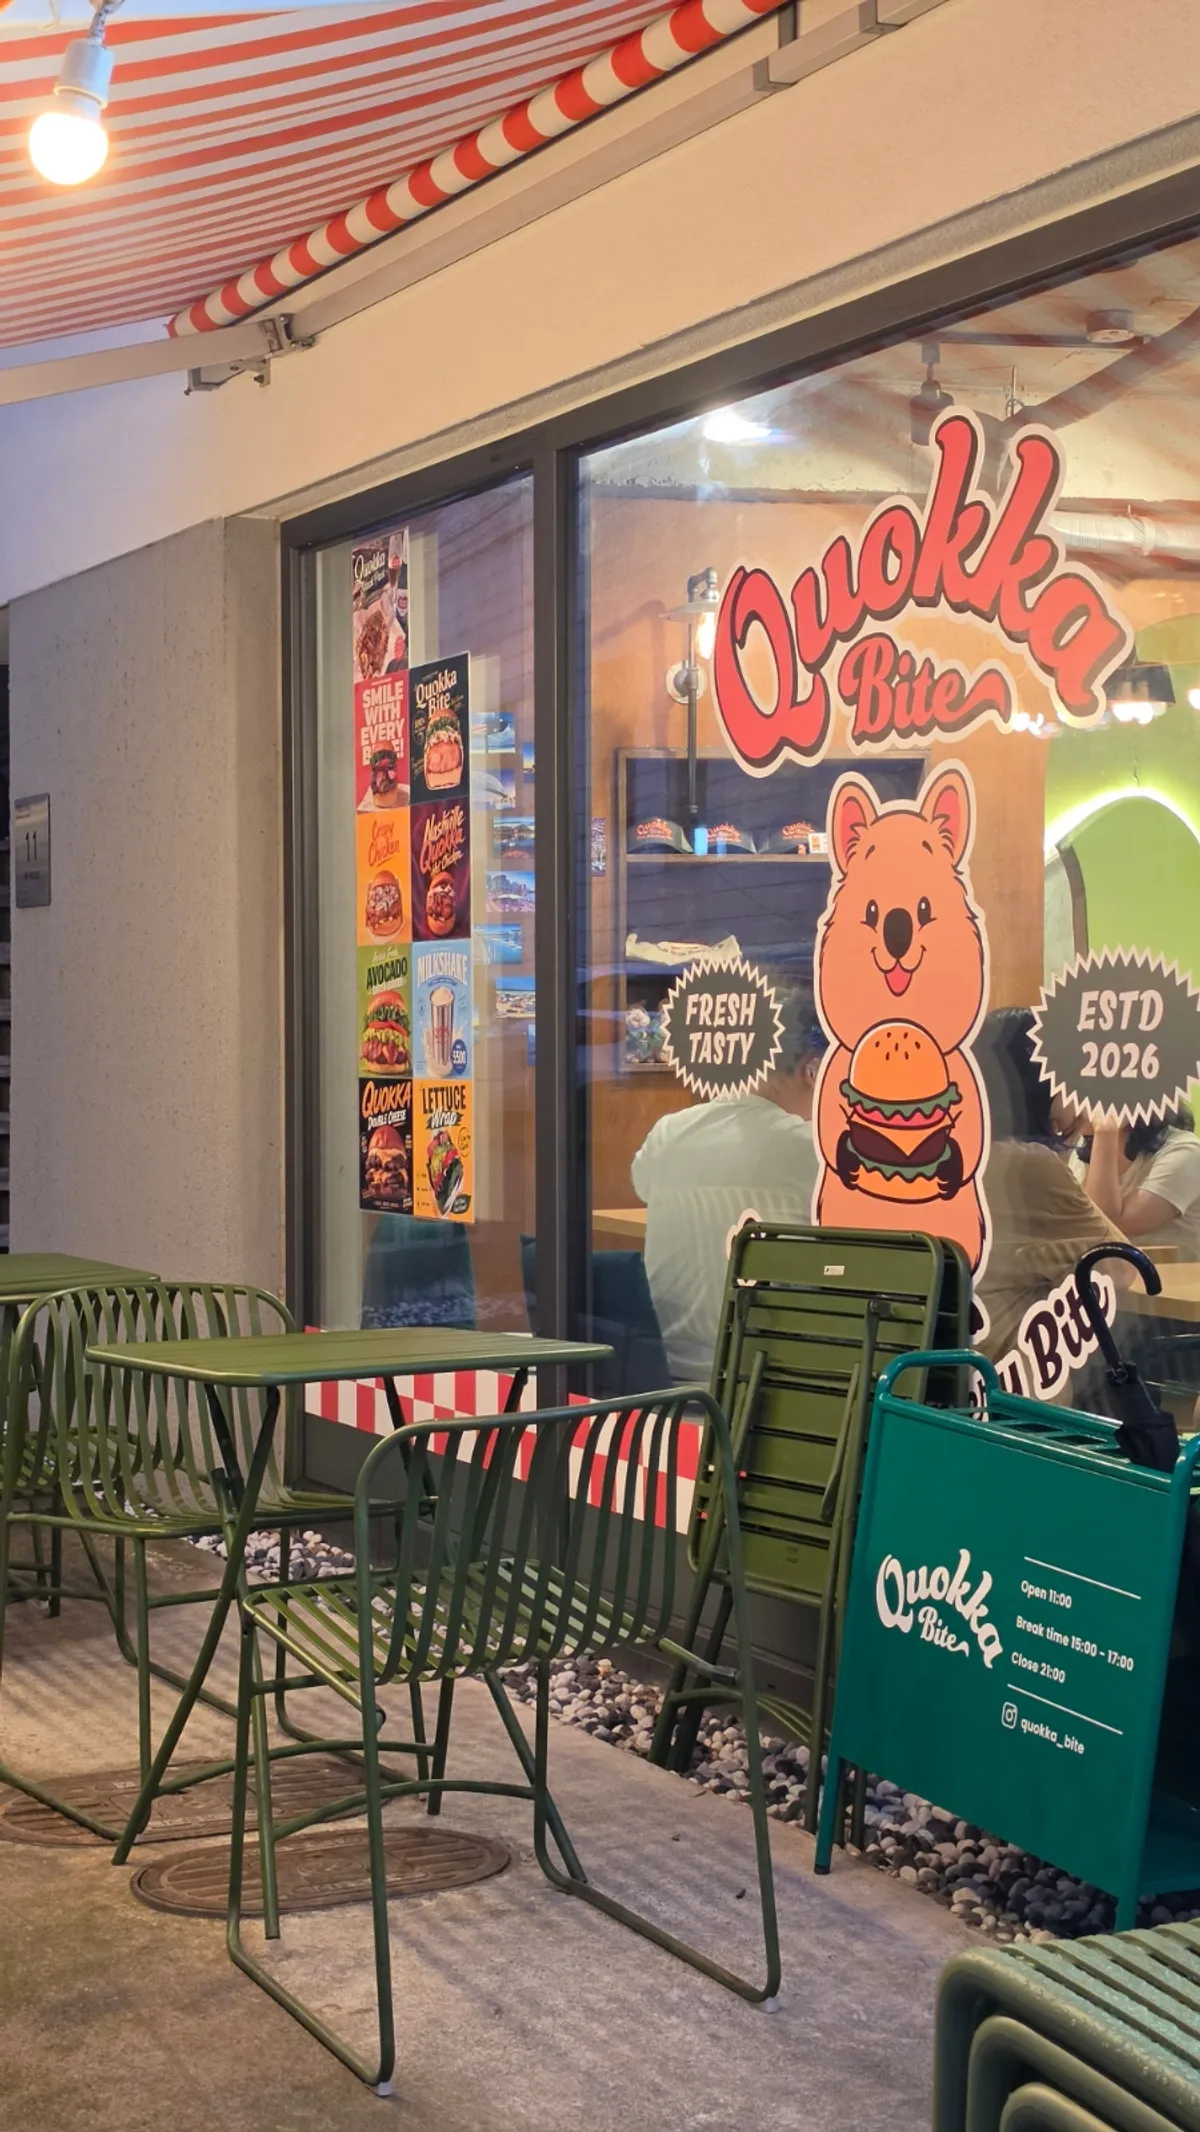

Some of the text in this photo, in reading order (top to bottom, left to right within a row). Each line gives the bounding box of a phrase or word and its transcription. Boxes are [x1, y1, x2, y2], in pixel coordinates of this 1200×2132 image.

[714, 413, 1129, 769] Quokka
[362, 681, 404, 709] SMILE
[416, 669, 457, 709] Quokka
[429, 692, 450, 718] Bite
[838, 631, 1011, 747] Bite
[365, 701, 401, 727] WITH
[361, 718, 405, 748] EVERY
[362, 738, 404, 767] BE!
[423, 805, 465, 843] Nashville
[25, 831, 37, 862] 11
[368, 838, 399, 867] Chicken
[420, 828, 465, 874] Quokka
[366, 956, 408, 990] AVOCADO
[417, 951, 468, 988] MILKSHAKE
[685, 992, 757, 1028] FRESH
[1077, 989, 1164, 1032] ESTD
[689, 1031, 756, 1066] TASTY
[1080, 1041, 1161, 1080] 2026
[362, 1080, 412, 1119] QUOKKA
[422, 1085, 466, 1114] LETTUCE
[367, 1114, 389, 1131] DOUBLE
[431, 1110, 459, 1130] Wrap
[876, 1548, 1004, 1669] Quokka
[1020, 1580, 1073, 1609] Open 11:00
[917, 1606, 970, 1658] Bite
[1015, 1615, 1045, 1637] Break
[1045, 1626, 1070, 1647] time
[1070, 1635, 1098, 1657] 15:00
[1106, 1649, 1135, 1671] 17:00
[1010, 1651, 1067, 1684] Close 21:00
[1020, 1717, 1086, 1755] quokka_bite
